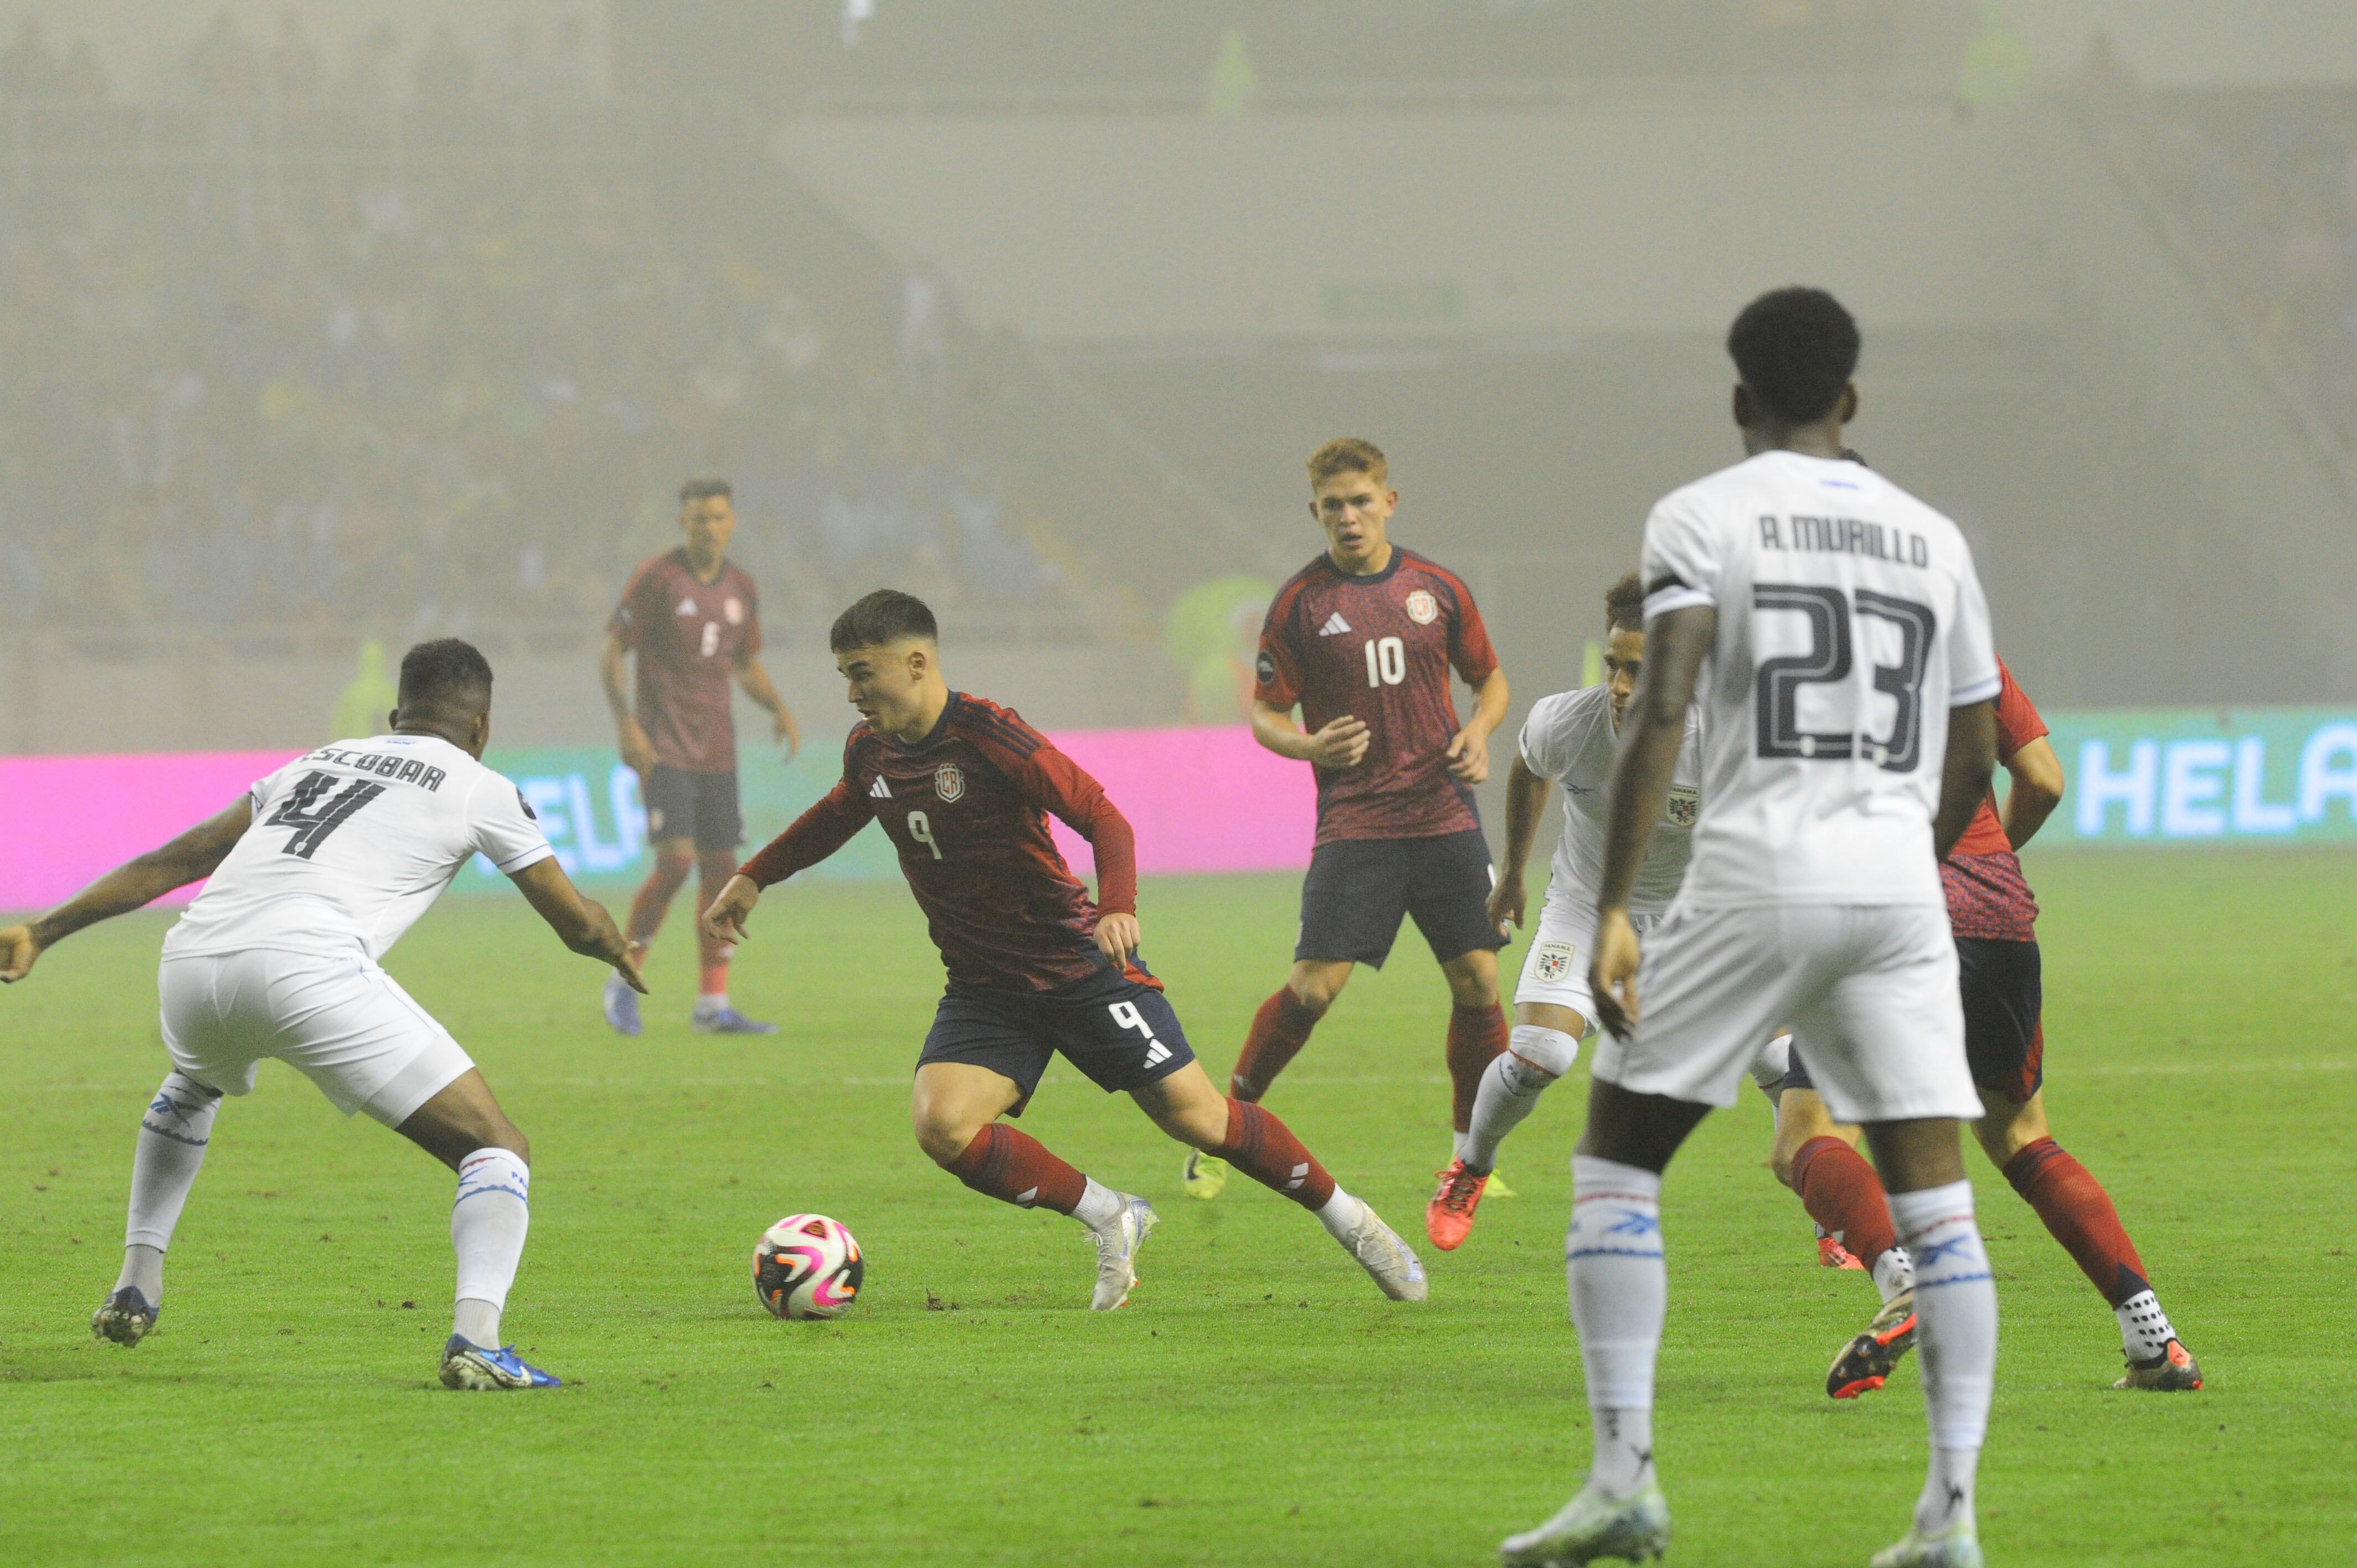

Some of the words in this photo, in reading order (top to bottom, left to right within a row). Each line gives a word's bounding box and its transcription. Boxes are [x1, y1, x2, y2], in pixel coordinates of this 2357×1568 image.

[1759, 515, 1928, 569] A.MURILLO
[700, 620, 720, 657] 6
[1364, 636, 1406, 688] 10
[1753, 583, 1936, 773] 23
[263, 771, 387, 859] 4
[472, 762, 649, 875] ELA
[907, 811, 942, 860] 9
[1108, 1000, 1154, 1039] 9
